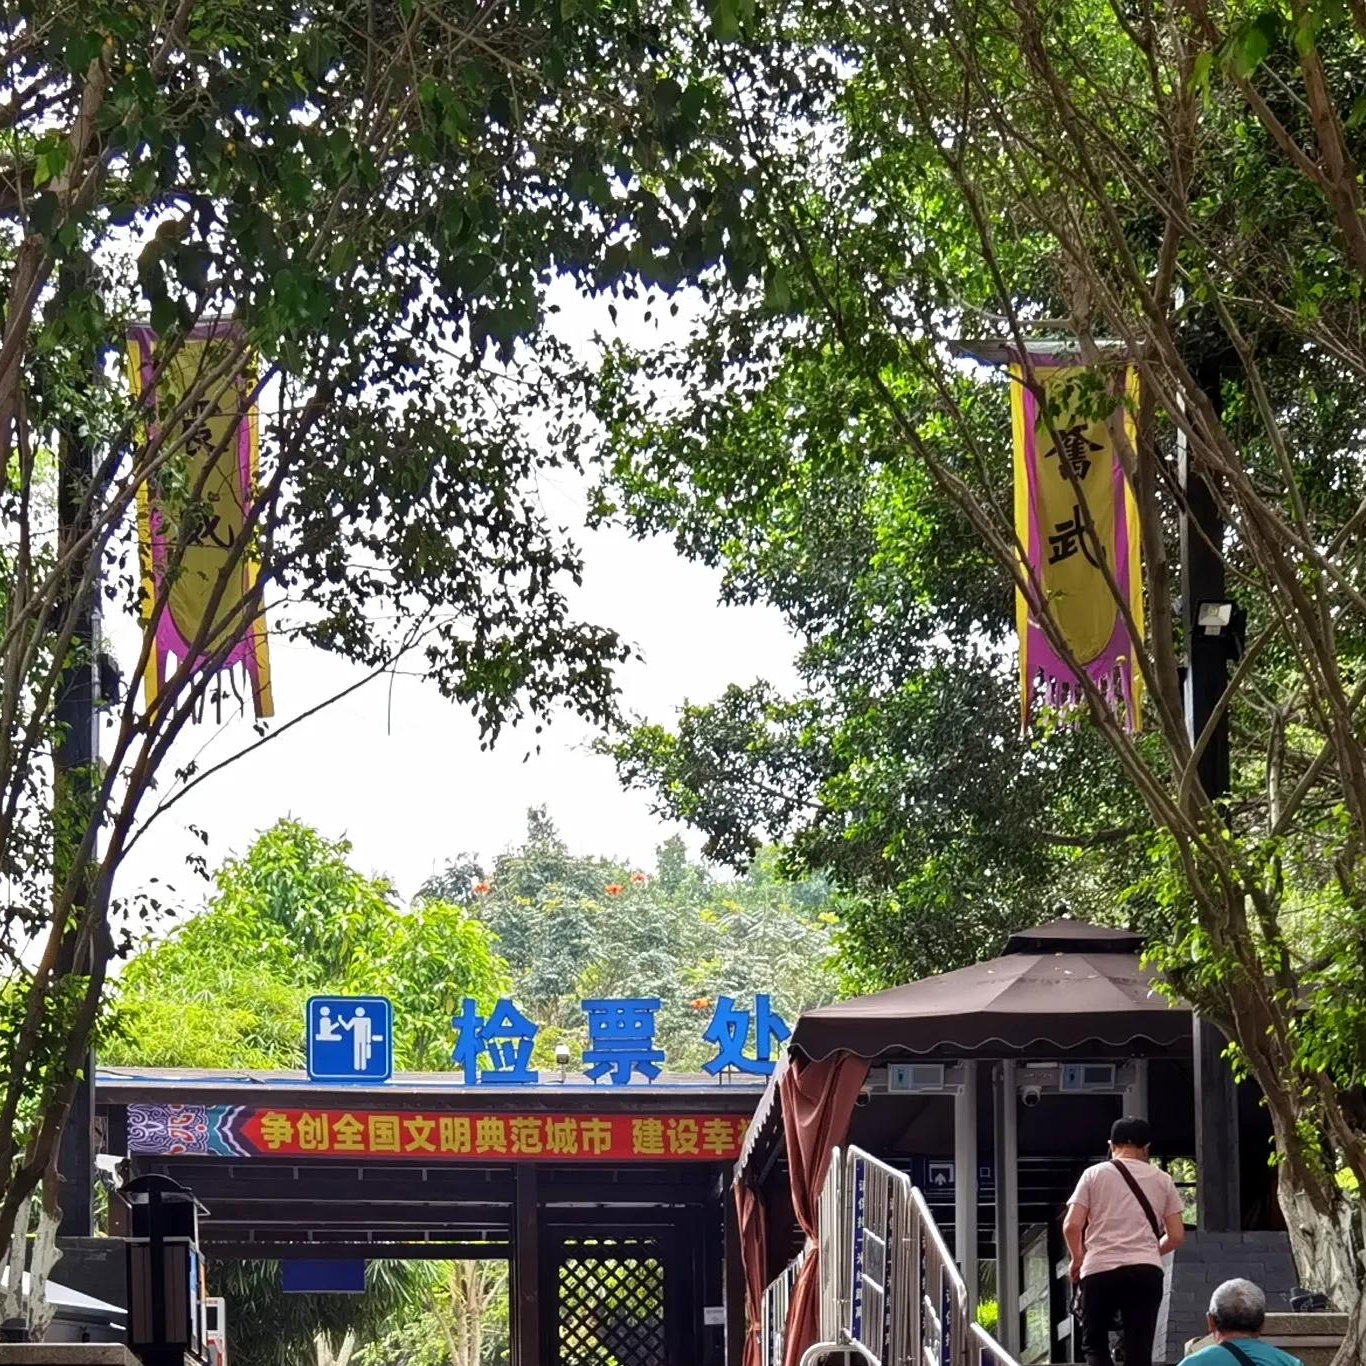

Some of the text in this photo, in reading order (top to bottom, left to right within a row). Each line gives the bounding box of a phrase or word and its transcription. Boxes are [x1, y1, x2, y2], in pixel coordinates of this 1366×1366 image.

[452, 993, 792, 1086] 检票处
[260, 1111, 612, 1155] 争创全国文明典范城市
